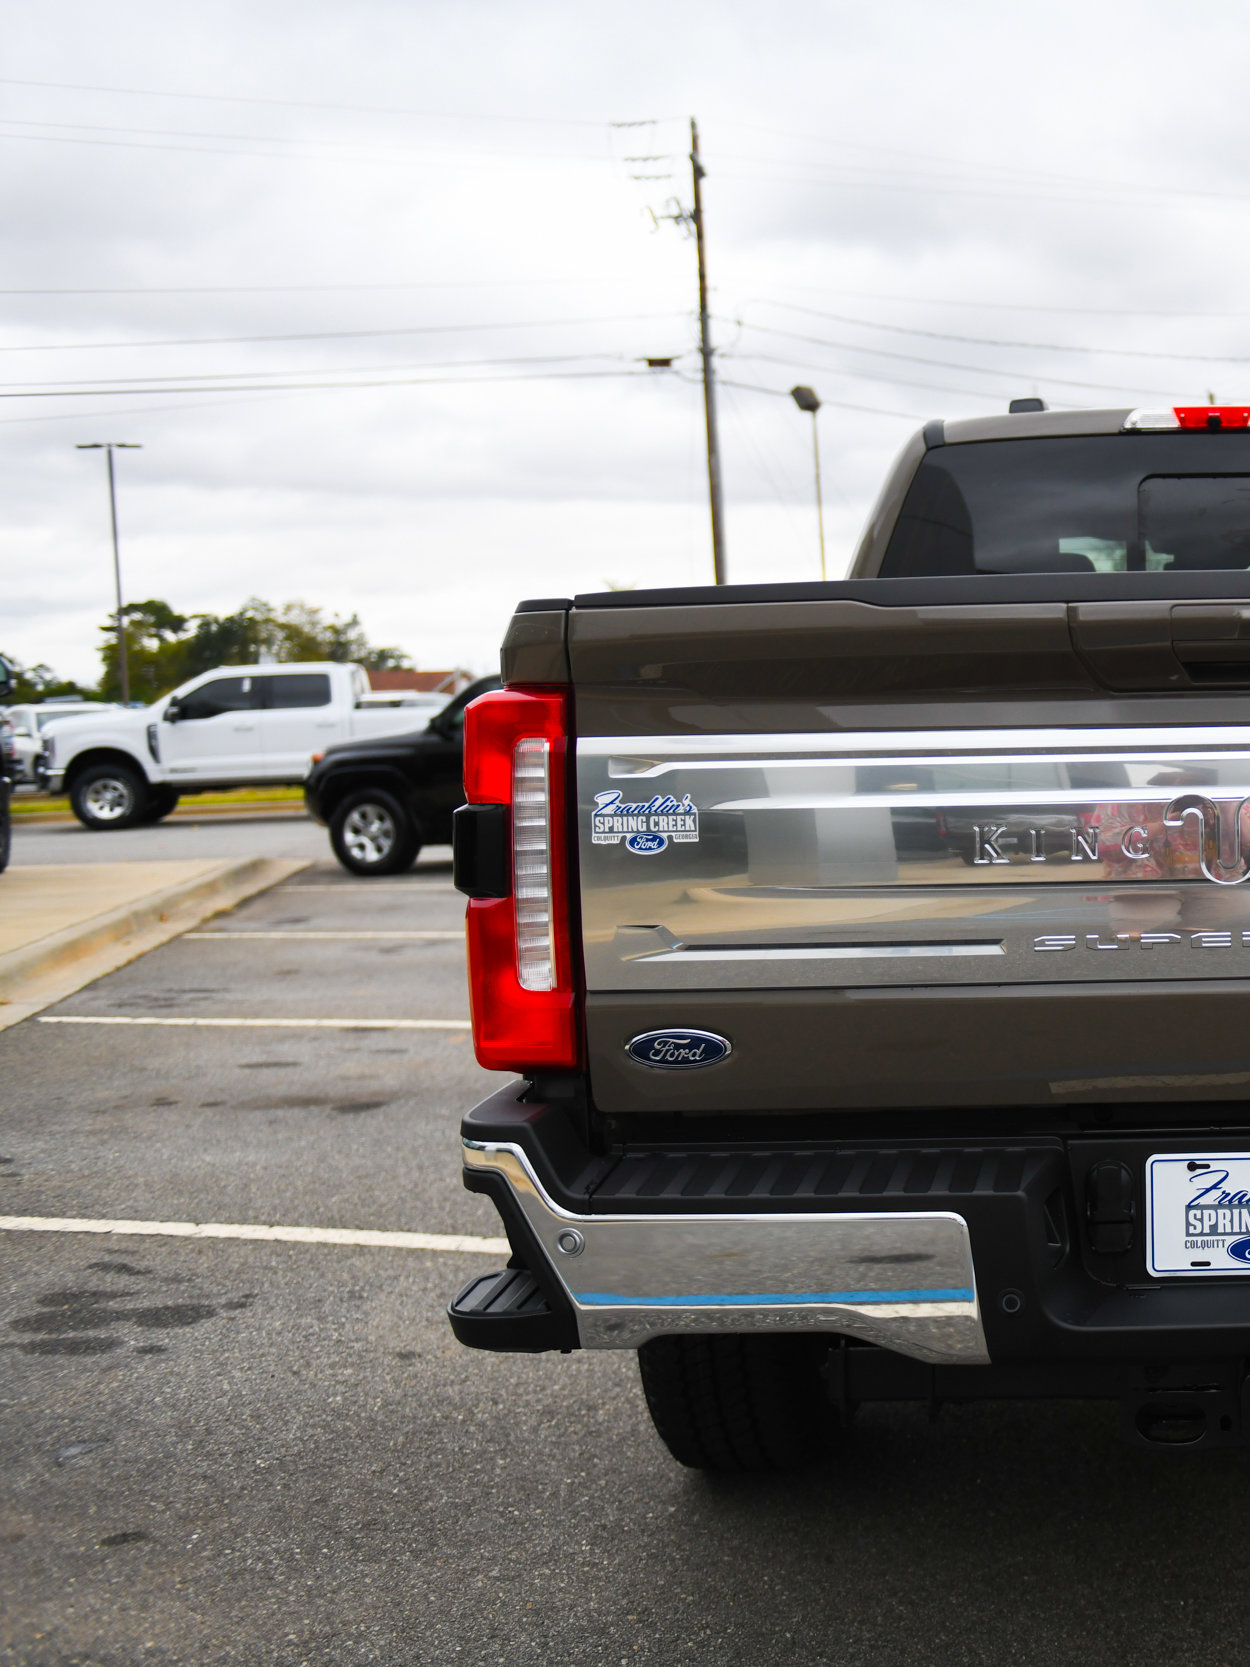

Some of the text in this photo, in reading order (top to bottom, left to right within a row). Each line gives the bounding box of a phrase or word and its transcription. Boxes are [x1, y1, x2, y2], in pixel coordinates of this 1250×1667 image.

[594, 792, 695, 815] Franklin's
[595, 815, 695, 832] SPRING CREEK
[634, 835, 660, 849] Ford
[972, 823, 1152, 865] KING
[649, 1038, 705, 1061] Ford
[1184, 1239, 1226, 1250] COLQUITT
